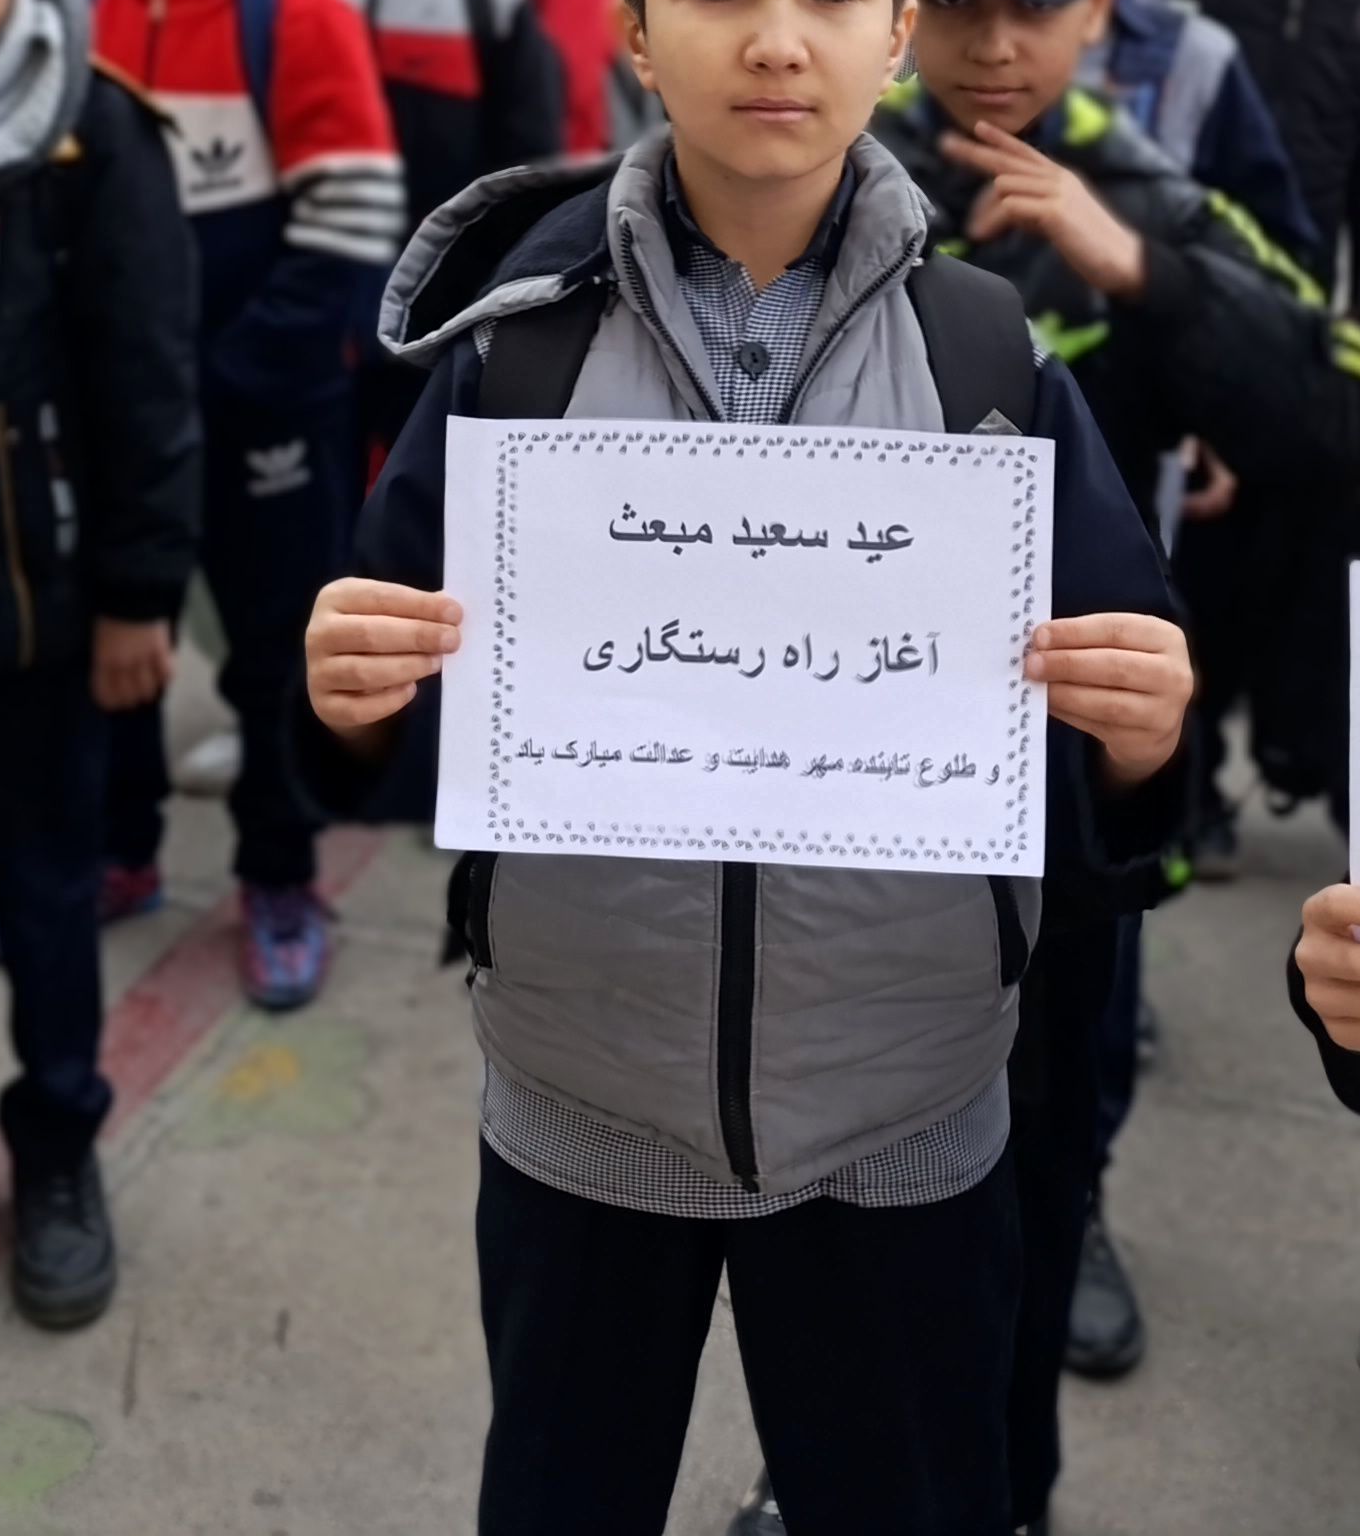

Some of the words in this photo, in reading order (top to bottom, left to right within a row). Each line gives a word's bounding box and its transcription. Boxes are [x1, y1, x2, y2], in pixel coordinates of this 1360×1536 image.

[609, 503, 712, 555] مبعث
[732, 516, 828, 559] سعید
[847, 521, 914, 563] عید
[583, 619, 765, 678] رستگاری
[783, 634, 839, 682] راه
[856, 630, 941, 684] آغاز
[552, 740, 622, 768] مبارک
[629, 742, 693, 763] عدالت
[704, 753, 724, 772] و
[918, 753, 976, 788] طلوع
[986, 764, 1000, 785] و
